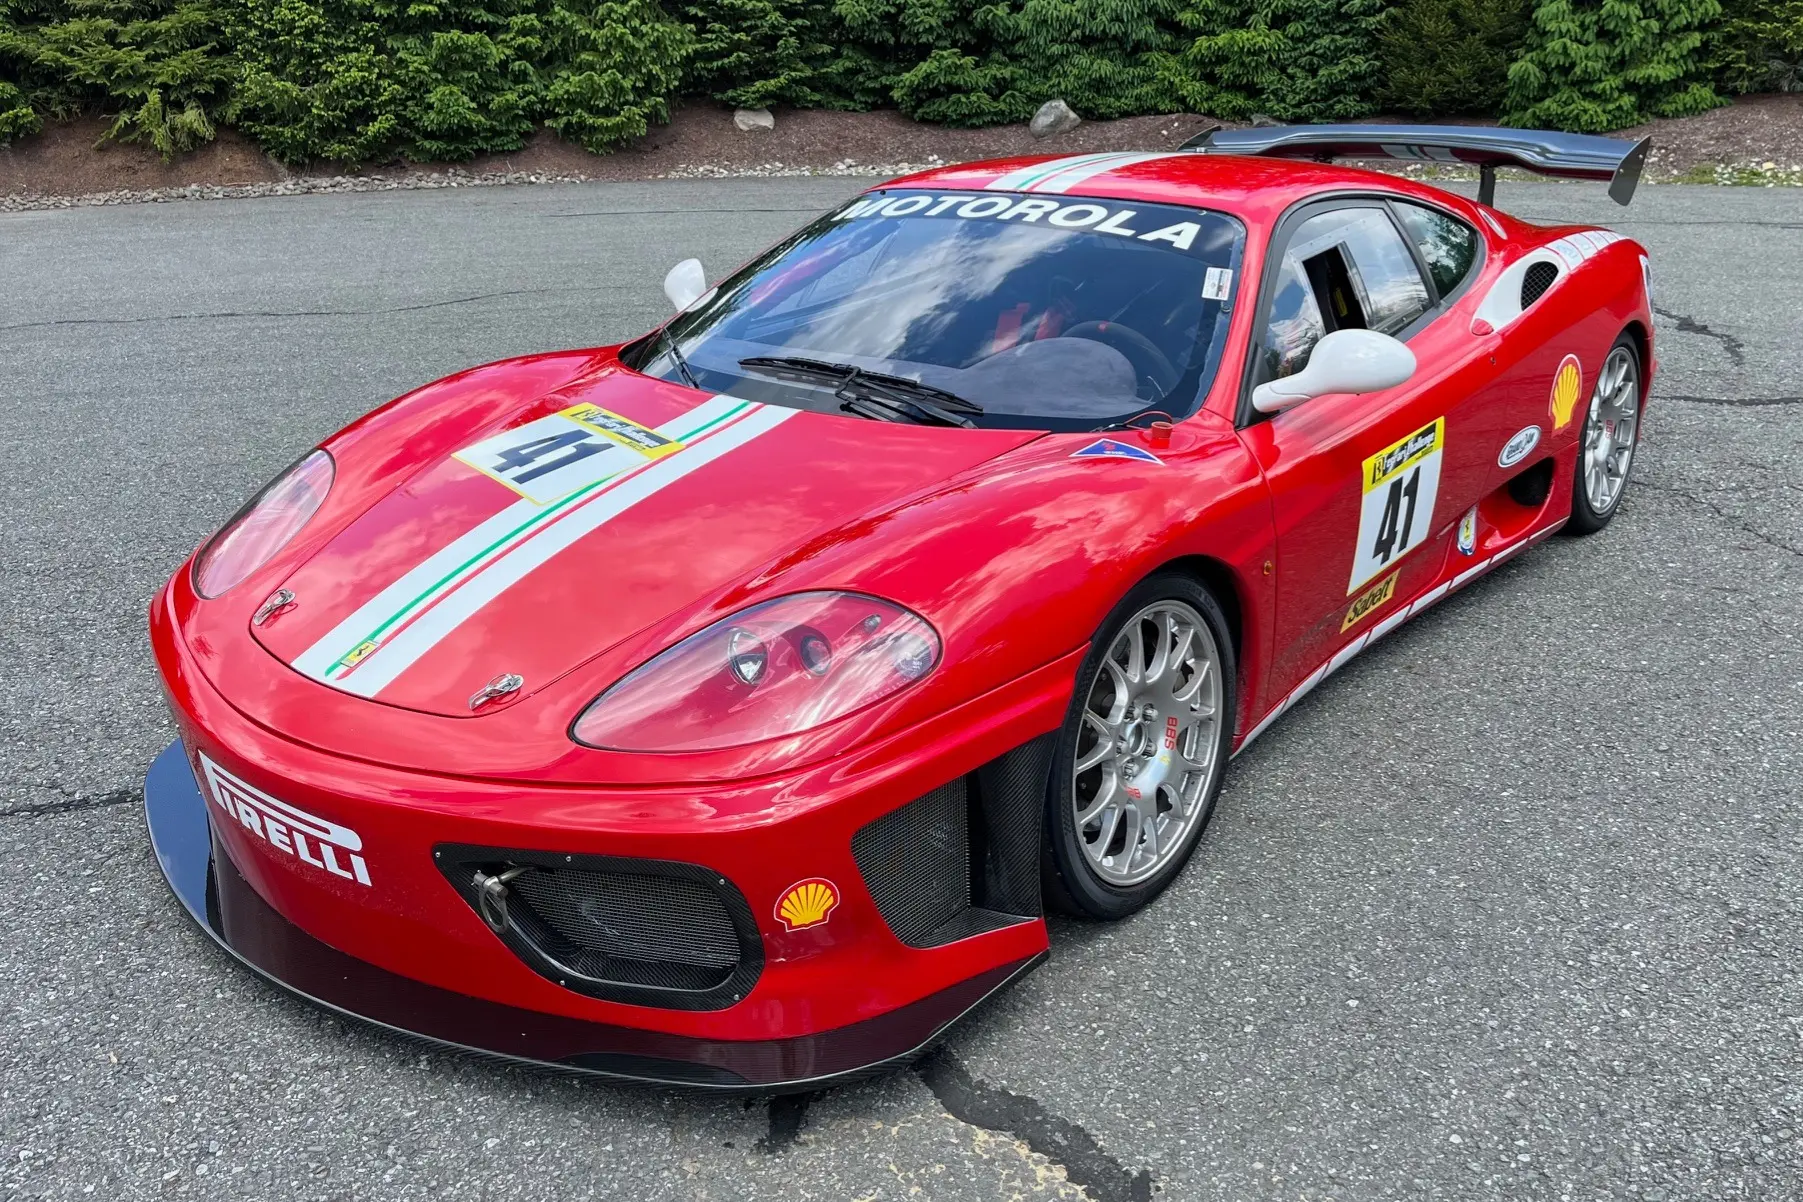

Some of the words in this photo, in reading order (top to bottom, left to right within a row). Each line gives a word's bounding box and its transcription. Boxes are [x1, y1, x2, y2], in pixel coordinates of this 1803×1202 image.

[831, 195, 1202, 250] MOTOROLA
[491, 429, 616, 485] 41
[1372, 466, 1421, 566] 41
[1164, 716, 1179, 751] BBS
[197, 749, 372, 887] PIRELLI
